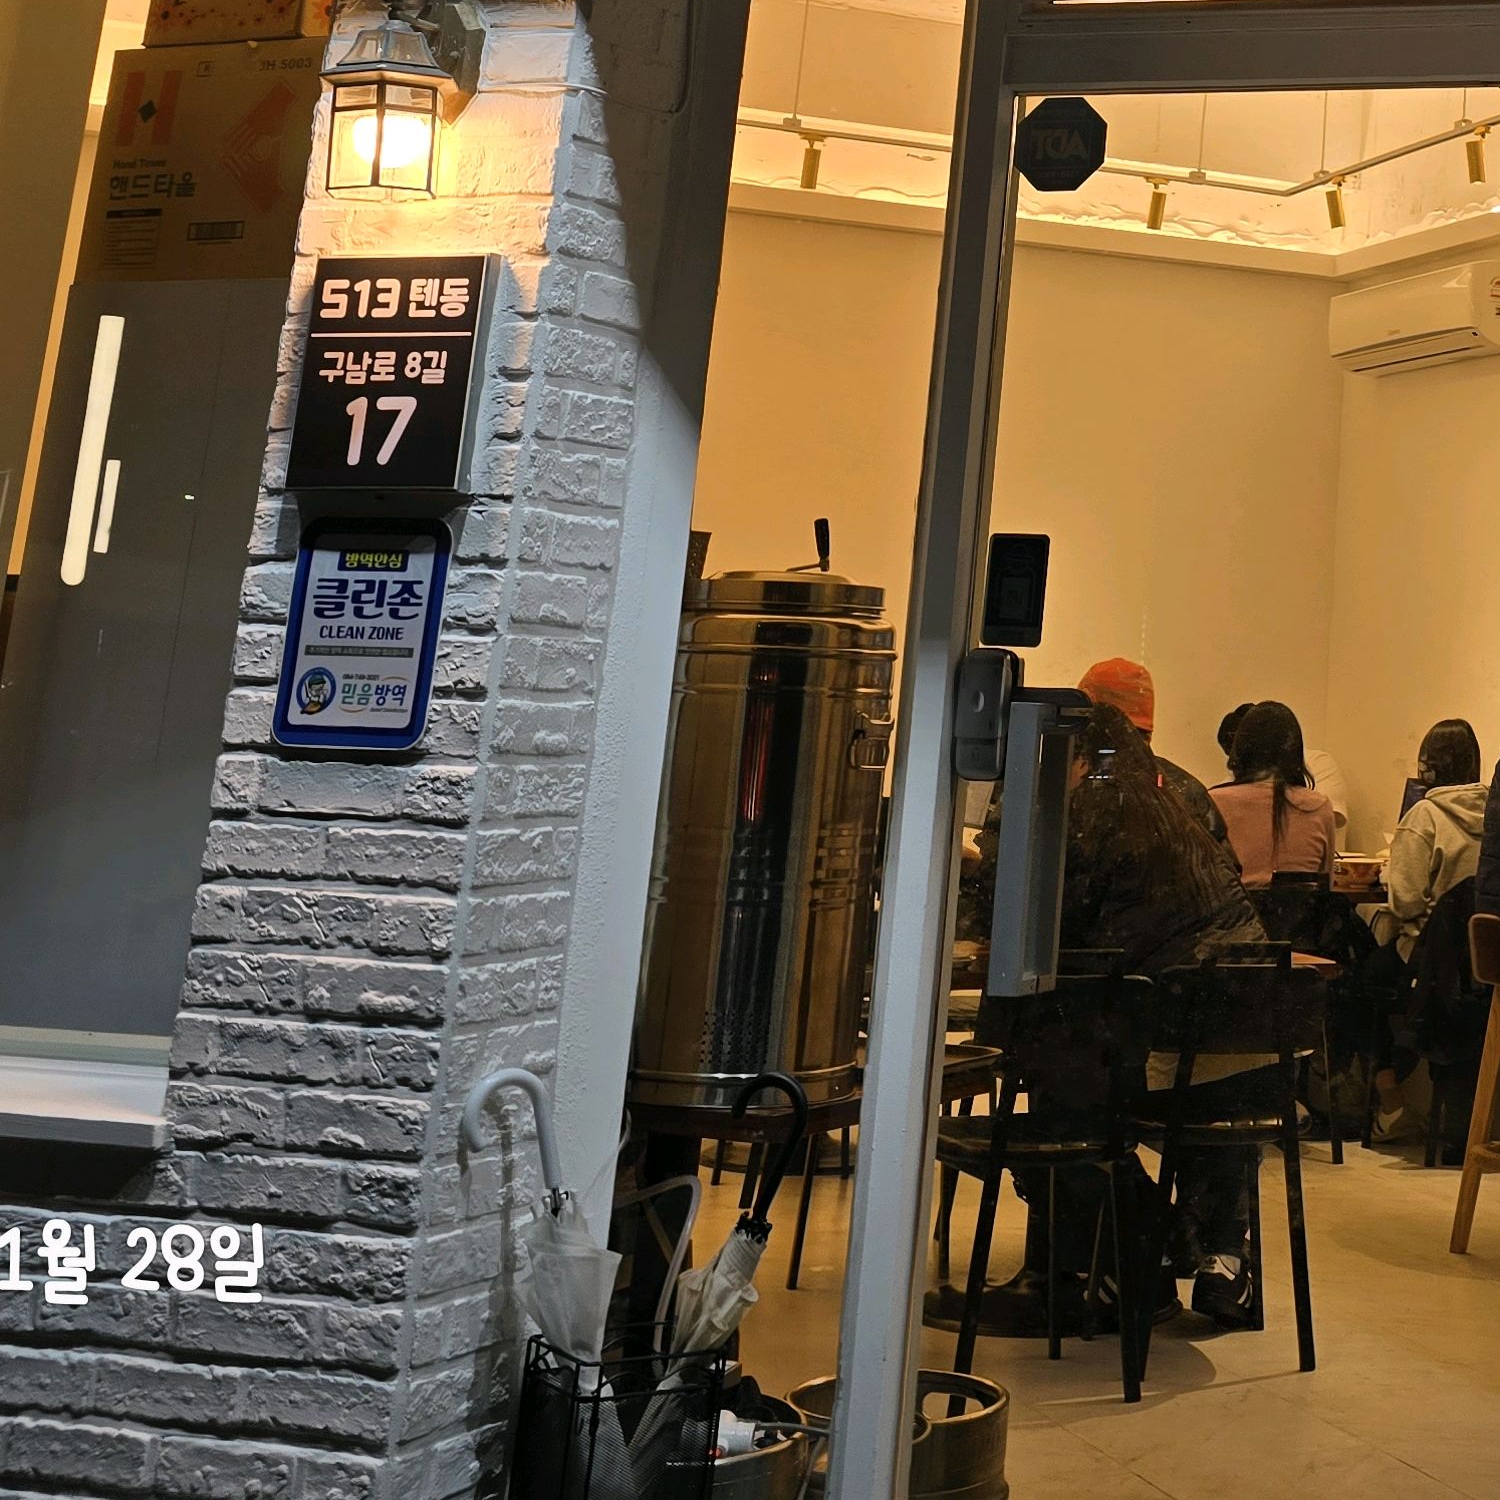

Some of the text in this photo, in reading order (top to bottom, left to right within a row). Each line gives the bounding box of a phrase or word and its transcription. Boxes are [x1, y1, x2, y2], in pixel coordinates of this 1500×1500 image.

[280, 57, 313, 70] 5003
[320, 277, 470, 319] 513 텐동
[318, 350, 448, 385] 구남로 8길
[346, 396, 418, 466] 17
[345, 552, 403, 569] 방역안심
[313, 578, 424, 621] 클린존
[319, 625, 405, 641] CLEAN ZONE
[341, 683, 407, 707] 믿음방역
